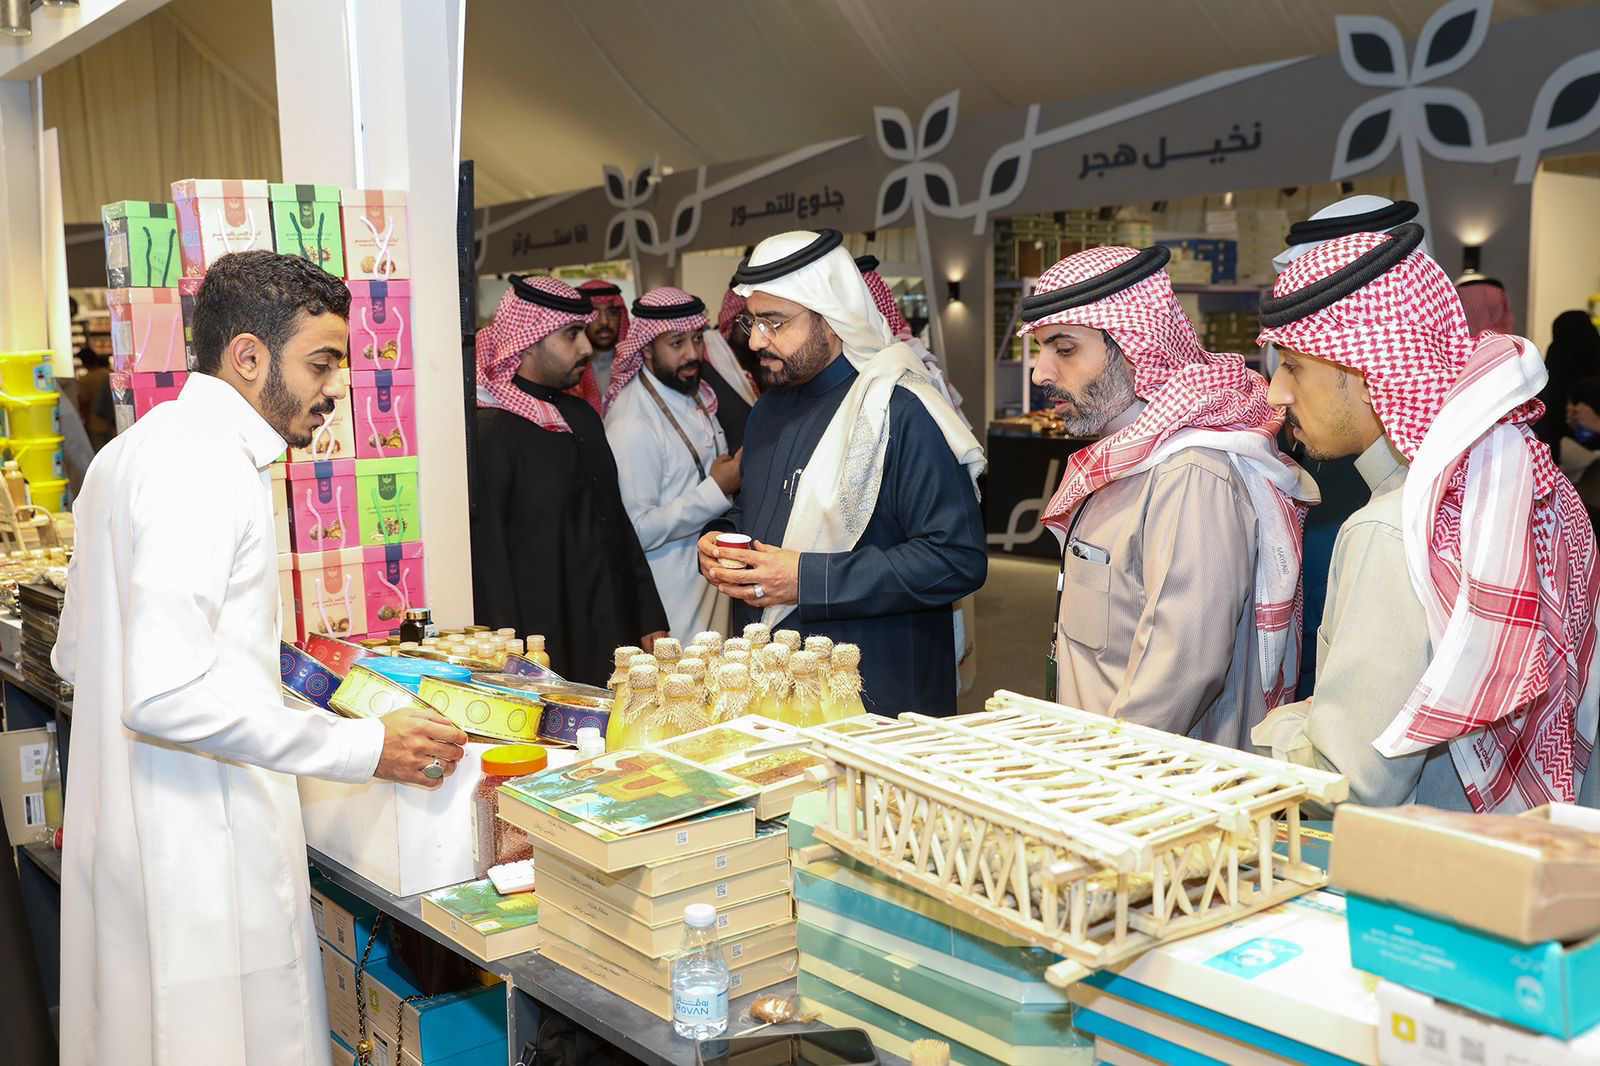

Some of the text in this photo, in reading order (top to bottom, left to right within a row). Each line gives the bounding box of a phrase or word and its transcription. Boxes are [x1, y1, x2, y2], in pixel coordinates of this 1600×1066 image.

[1077, 121, 1263, 181] نخيل هجر
[729, 185, 845, 228] جذوع للتمور
